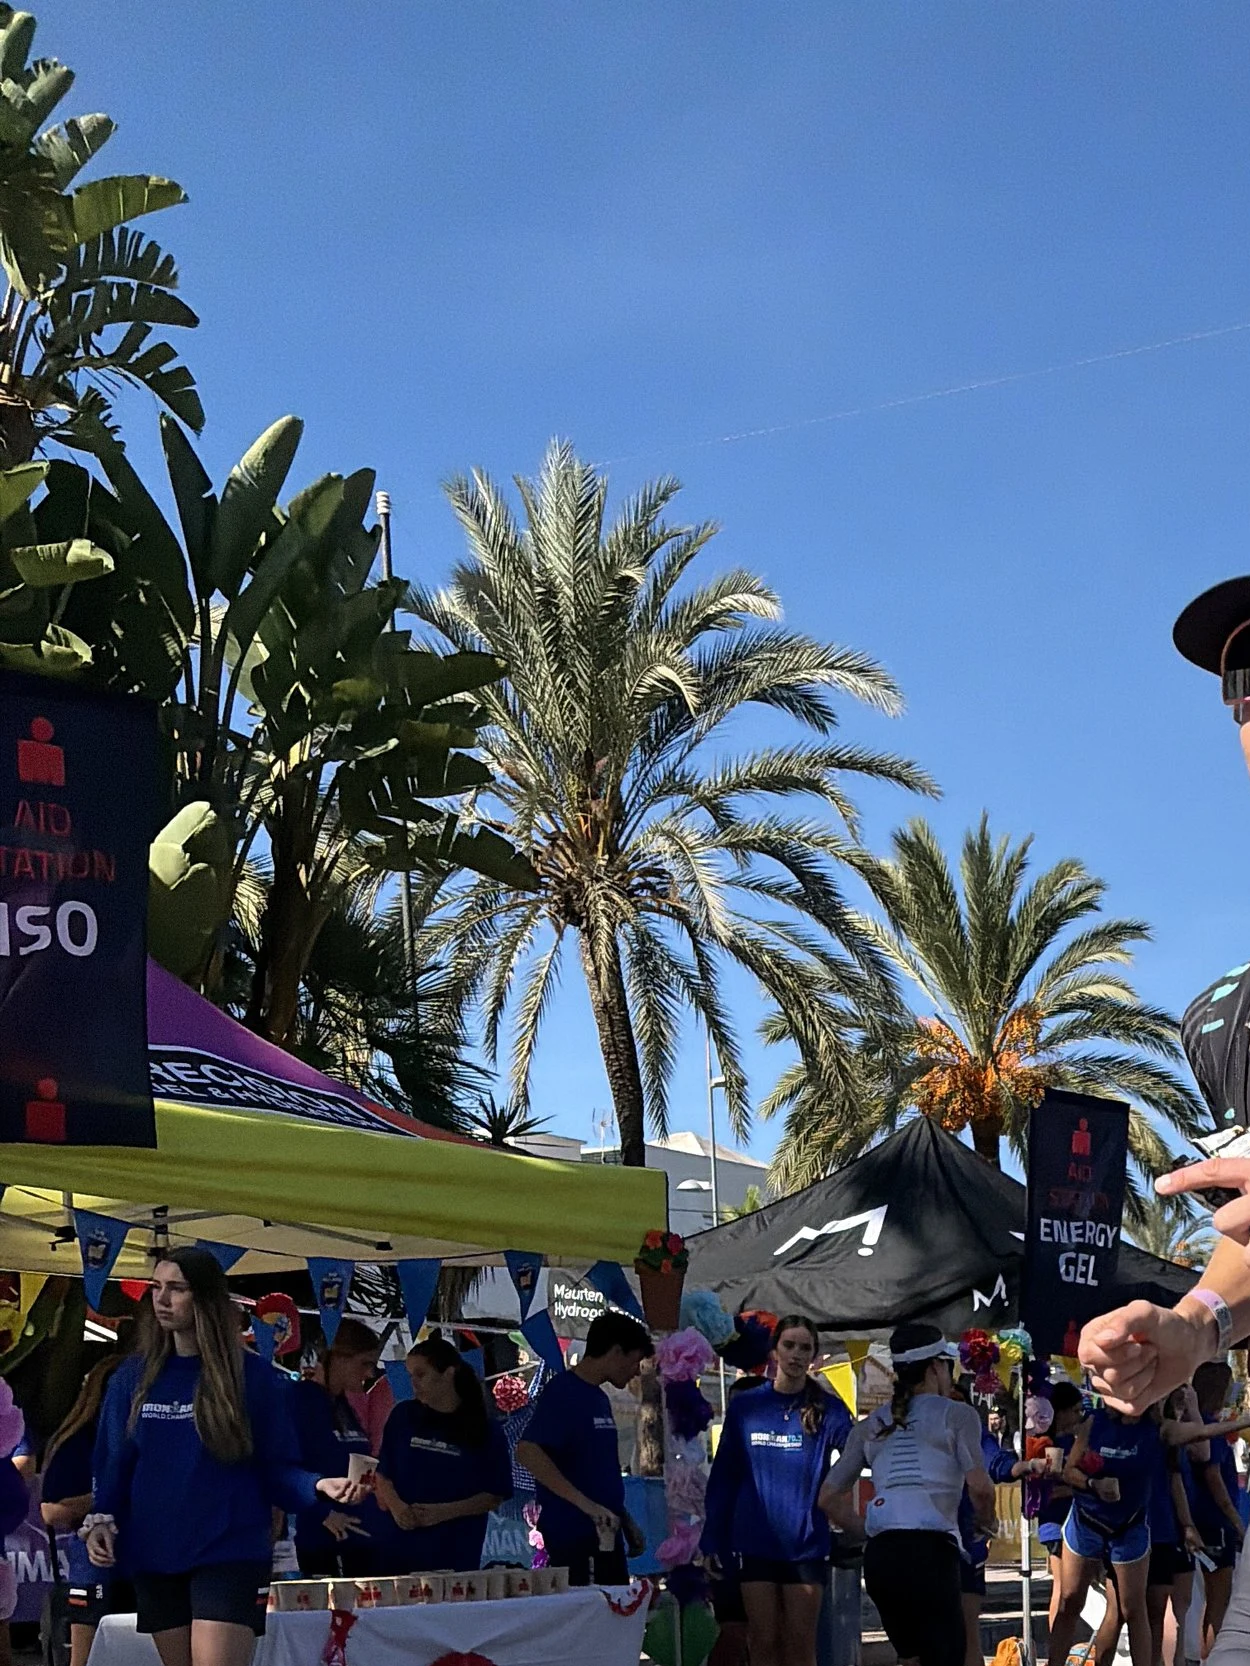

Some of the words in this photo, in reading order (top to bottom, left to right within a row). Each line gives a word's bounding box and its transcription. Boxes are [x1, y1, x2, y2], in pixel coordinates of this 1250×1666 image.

[14, 800, 72, 837] AID
[1039, 1217, 1119, 1249] ENERGY
[1058, 1251, 1100, 1288] GEL
[553, 1283, 604, 1303] Maurten
